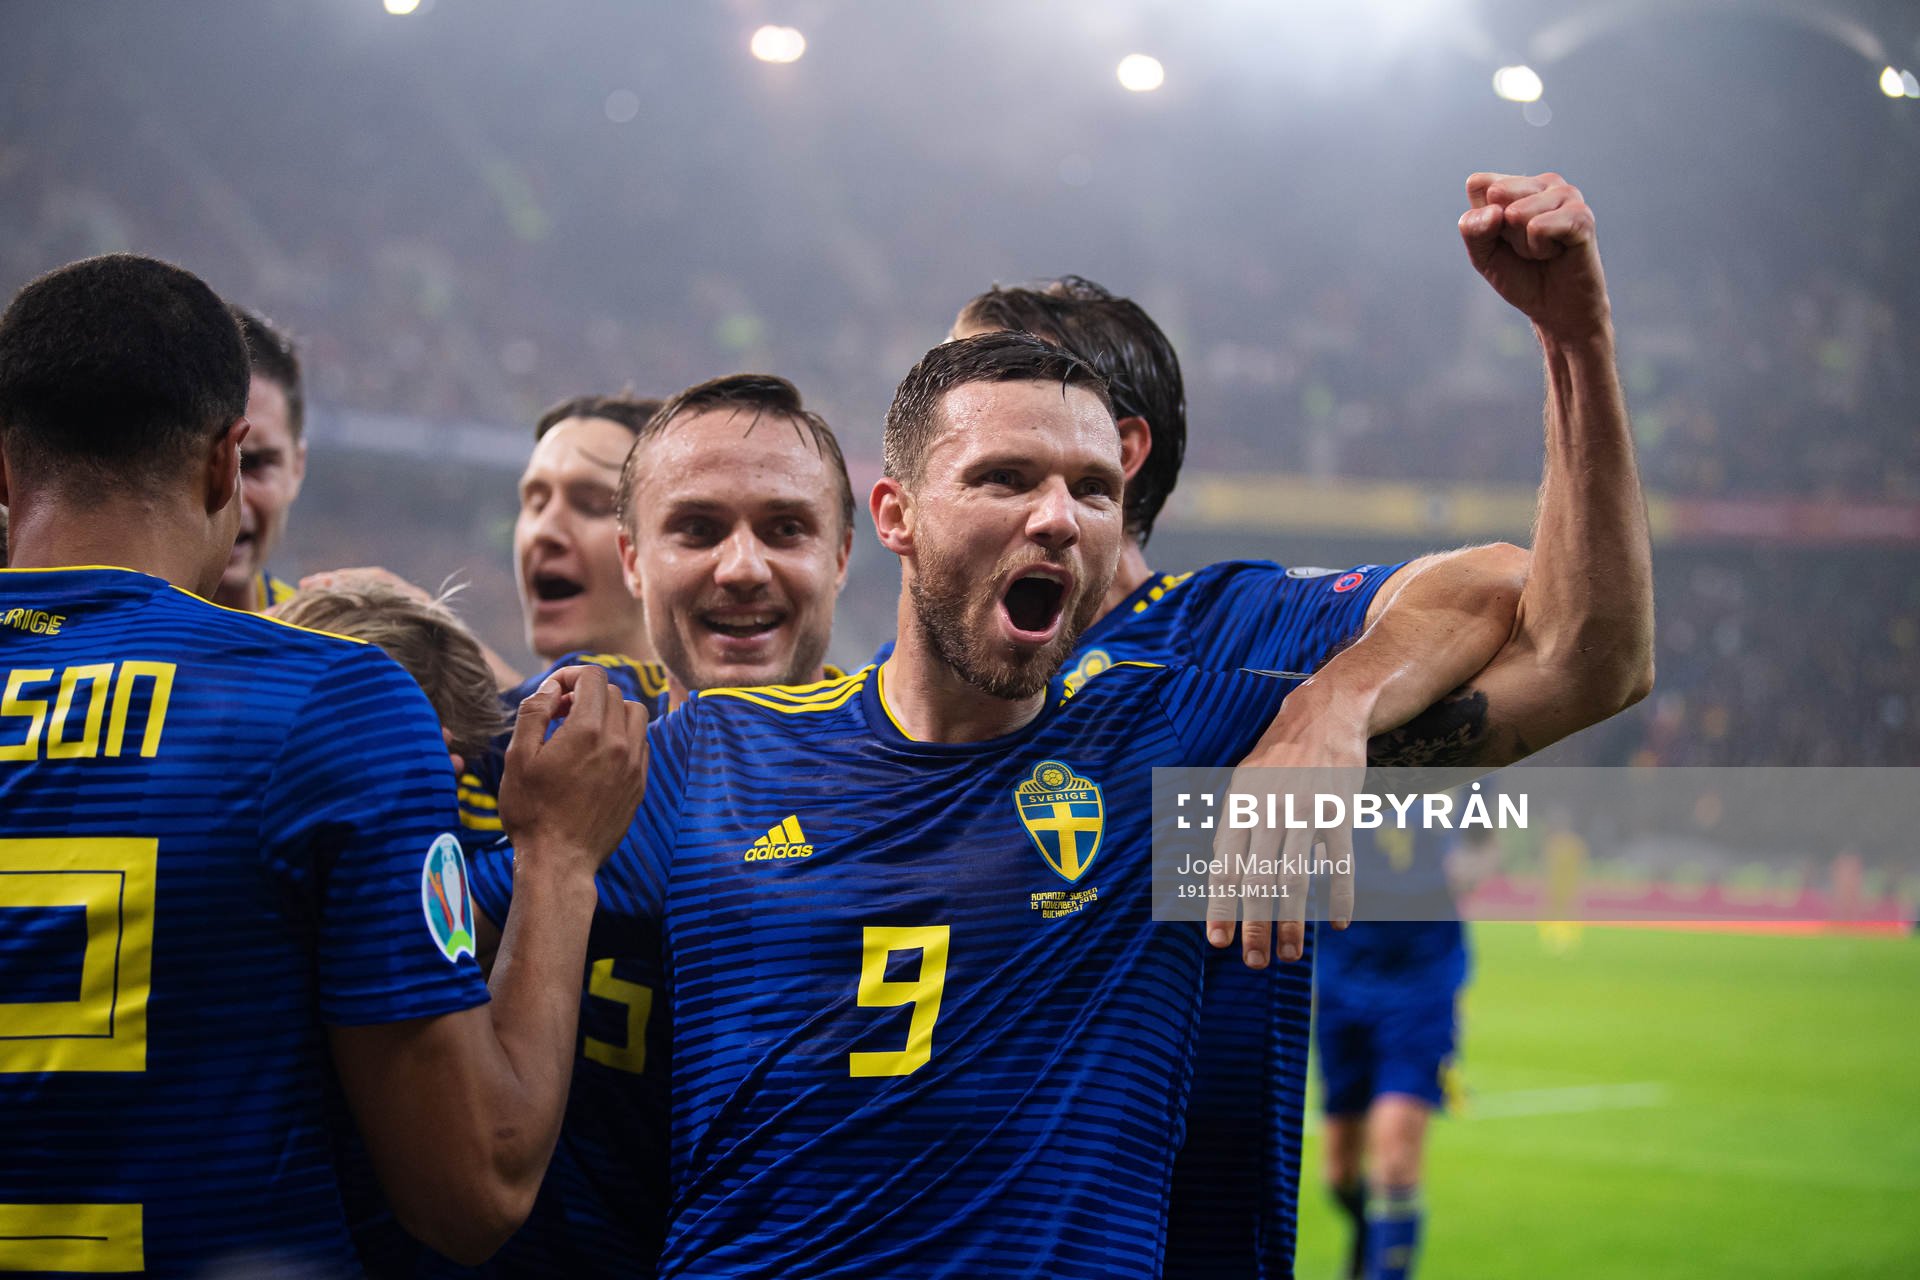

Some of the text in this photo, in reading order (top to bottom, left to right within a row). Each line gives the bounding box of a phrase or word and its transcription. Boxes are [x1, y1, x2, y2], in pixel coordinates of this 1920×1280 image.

[1029, 792, 1088, 803] SVERIGE
[744, 842, 813, 862] adidas
[1030, 893, 1098, 910] 15 NOVEMBER 2019
[850, 925, 950, 1077] 9
